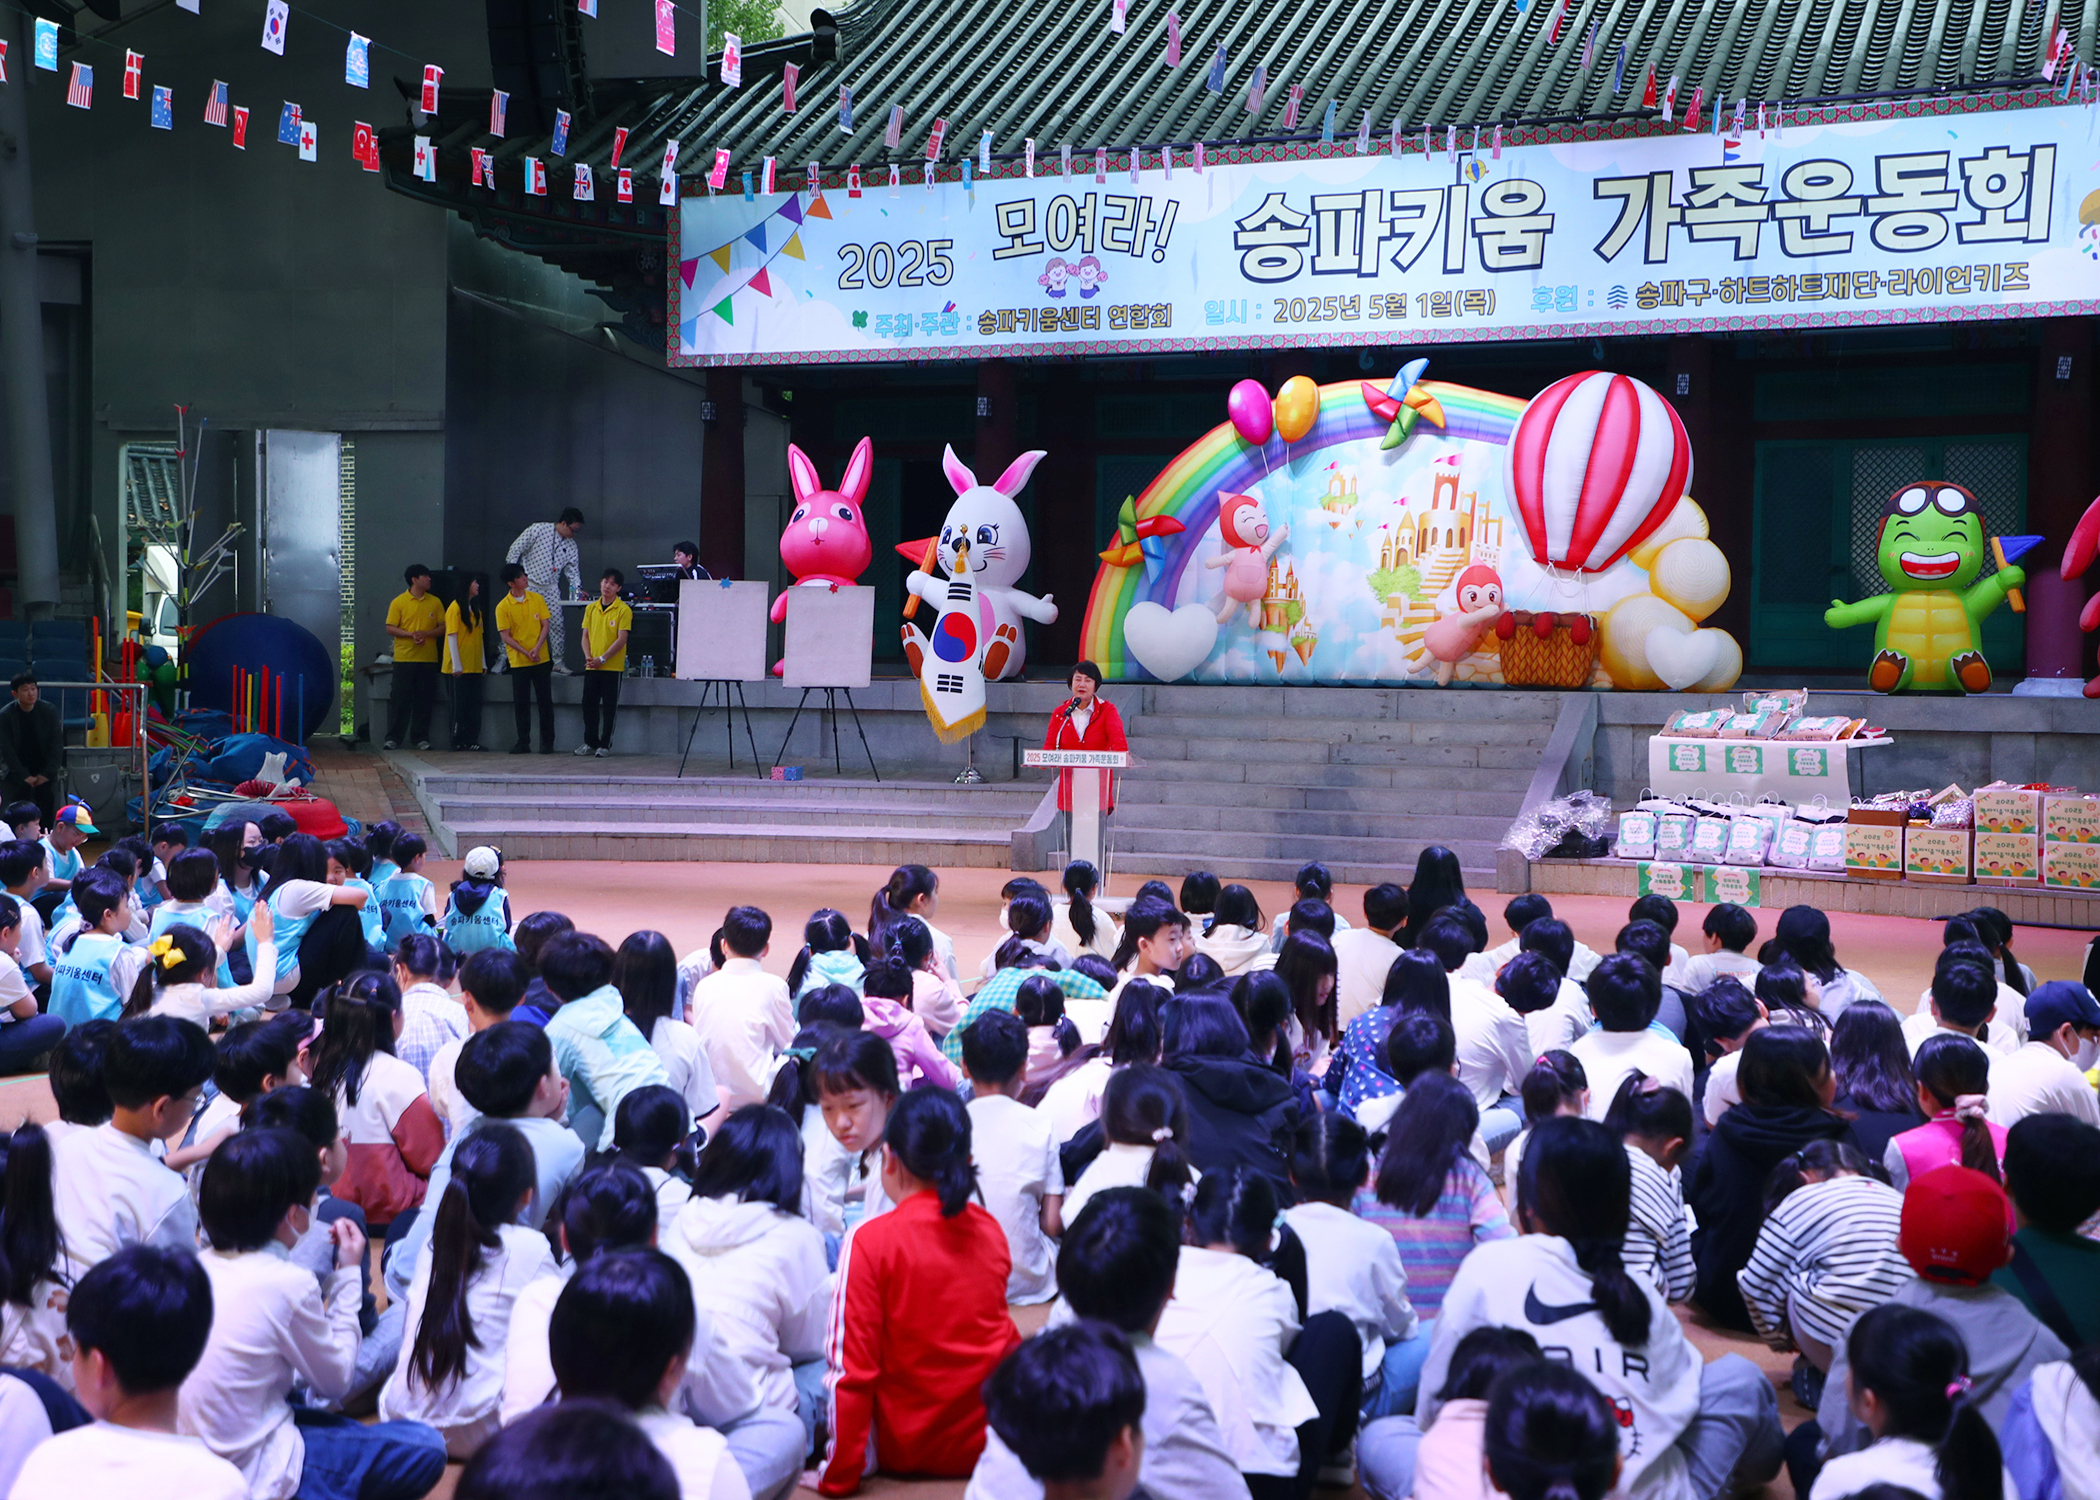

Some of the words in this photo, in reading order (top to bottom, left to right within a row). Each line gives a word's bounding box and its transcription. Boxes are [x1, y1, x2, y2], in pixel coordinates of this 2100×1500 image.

[837, 239, 955, 290] 2025
[992, 192, 1180, 263] 모여라!
[1234, 178, 1555, 284] 송파키움
[1593, 143, 2058, 264] 가족운동회
[1531, 285, 1579, 314] 후원
[1636, 262, 2031, 310] 송파구·하트하트재단·라이언키즈
[978, 306, 1101, 335] 송파키움센터
[1107, 303, 1173, 330] 연합회
[1204, 299, 1247, 326] 일시
[1273, 296, 1361, 324] 2025년
[1368, 293, 1408, 320] 5월
[1415, 289, 1497, 317] 1일(목)
[1027, 752, 1041, 763] 2025
[1063, 753, 1087, 764] 송파키움
[1088, 754, 1119, 764] 가족운동회
[56, 964, 104, 985] 파키움센터
